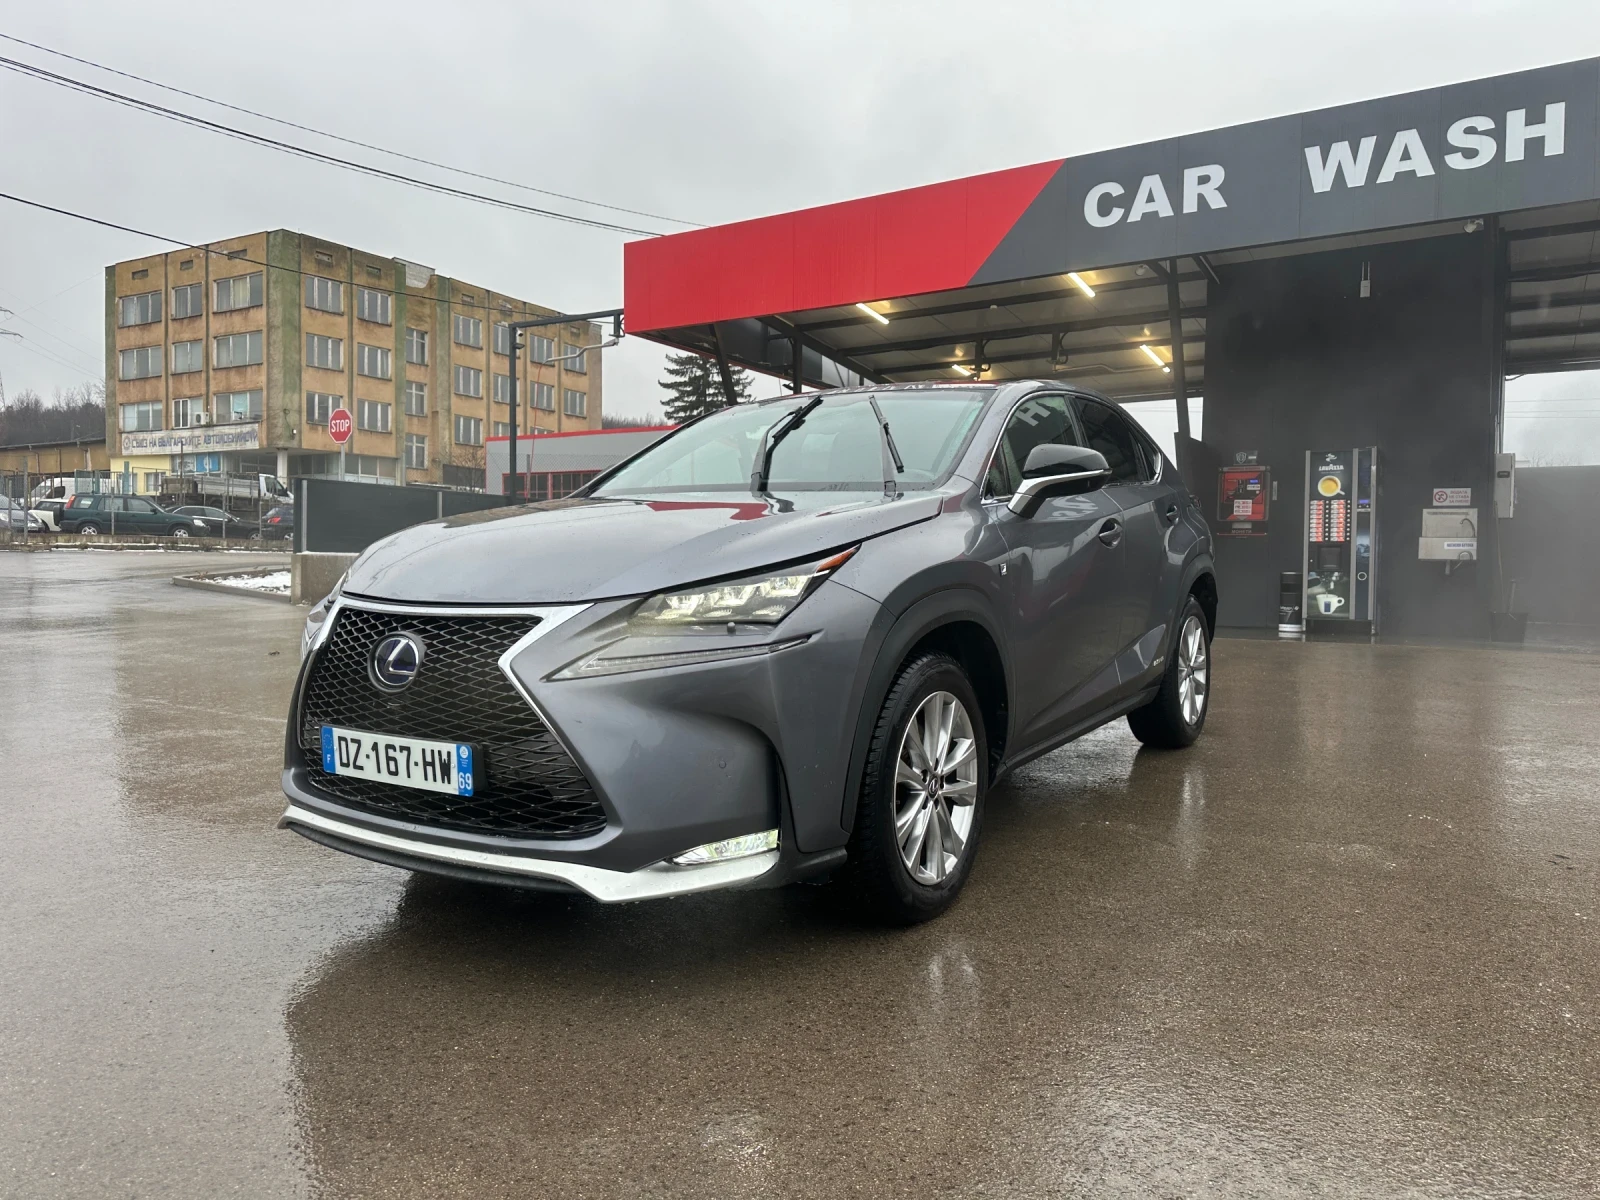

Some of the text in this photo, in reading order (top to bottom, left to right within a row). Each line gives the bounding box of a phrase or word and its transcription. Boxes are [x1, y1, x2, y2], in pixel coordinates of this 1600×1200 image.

[1083, 101, 1566, 229] CAR WASH
[331, 419, 350, 433] STOP
[149, 437, 157, 448] НА
[1318, 463, 1344, 471] LAVAZZA
[326, 753, 331, 764] F
[337, 735, 452, 785] DZ-167-HW
[458, 771, 472, 790] 69
